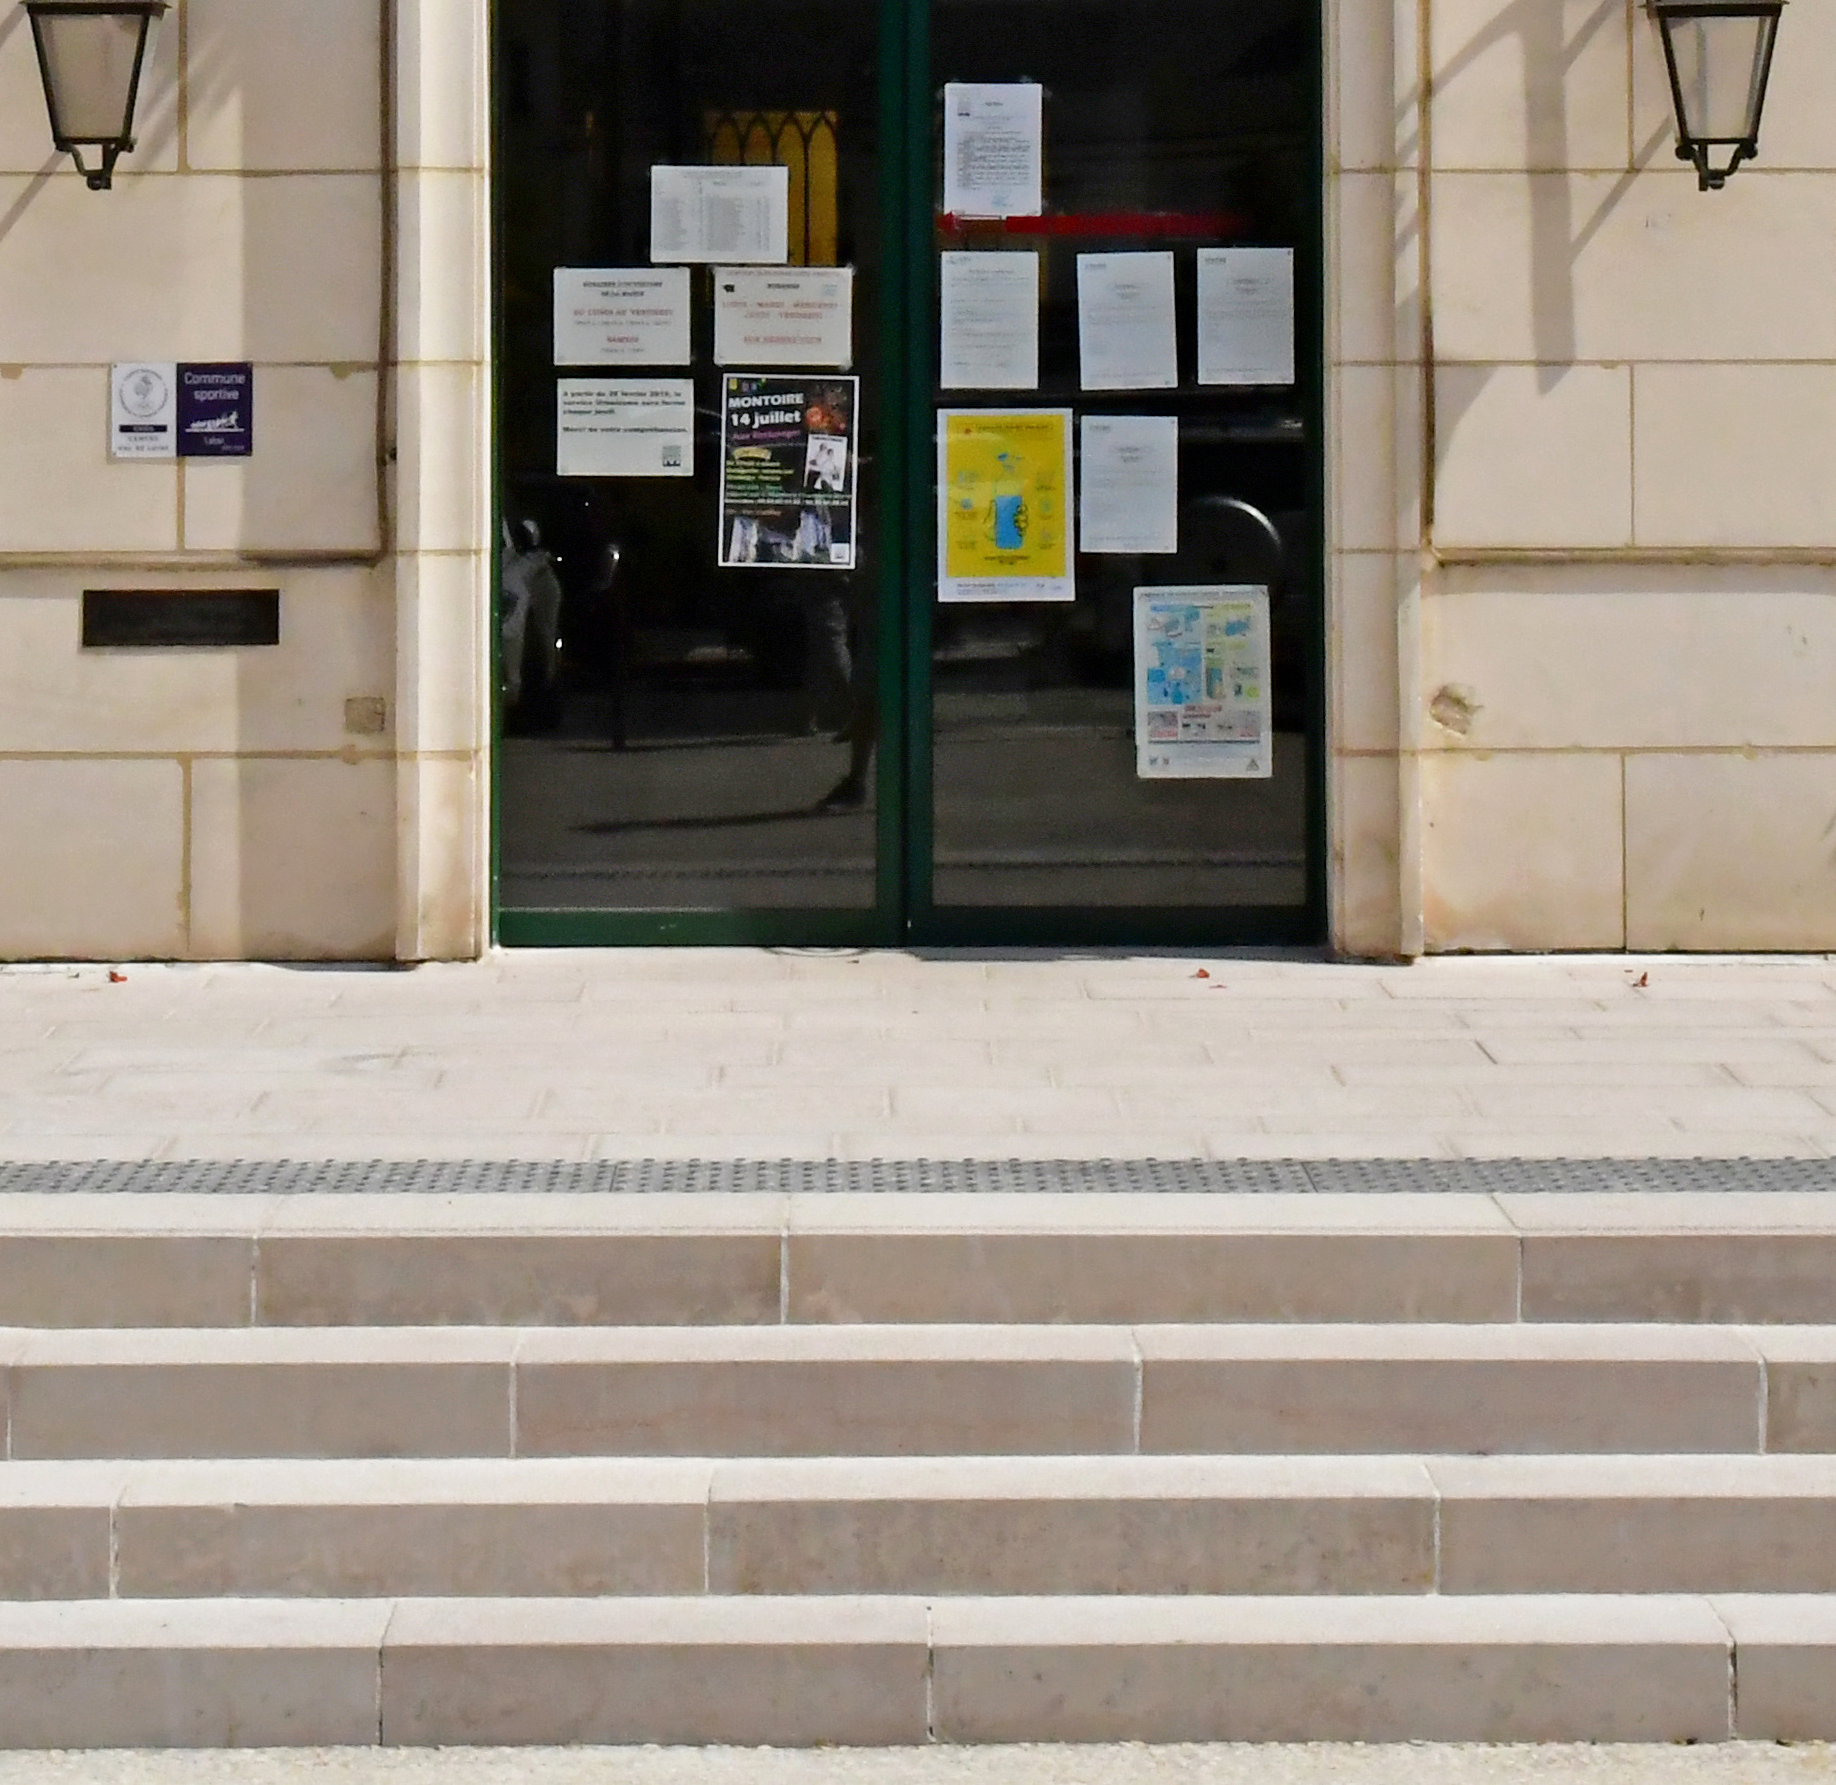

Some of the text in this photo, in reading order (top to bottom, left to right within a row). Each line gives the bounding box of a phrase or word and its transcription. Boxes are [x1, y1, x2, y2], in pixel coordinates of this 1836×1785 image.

[184, 372, 246, 384] Commune
[193, 388, 240, 402] sportive
[729, 393, 804, 408] MONTOIRE
[731, 410, 801, 429] 14 juillet
